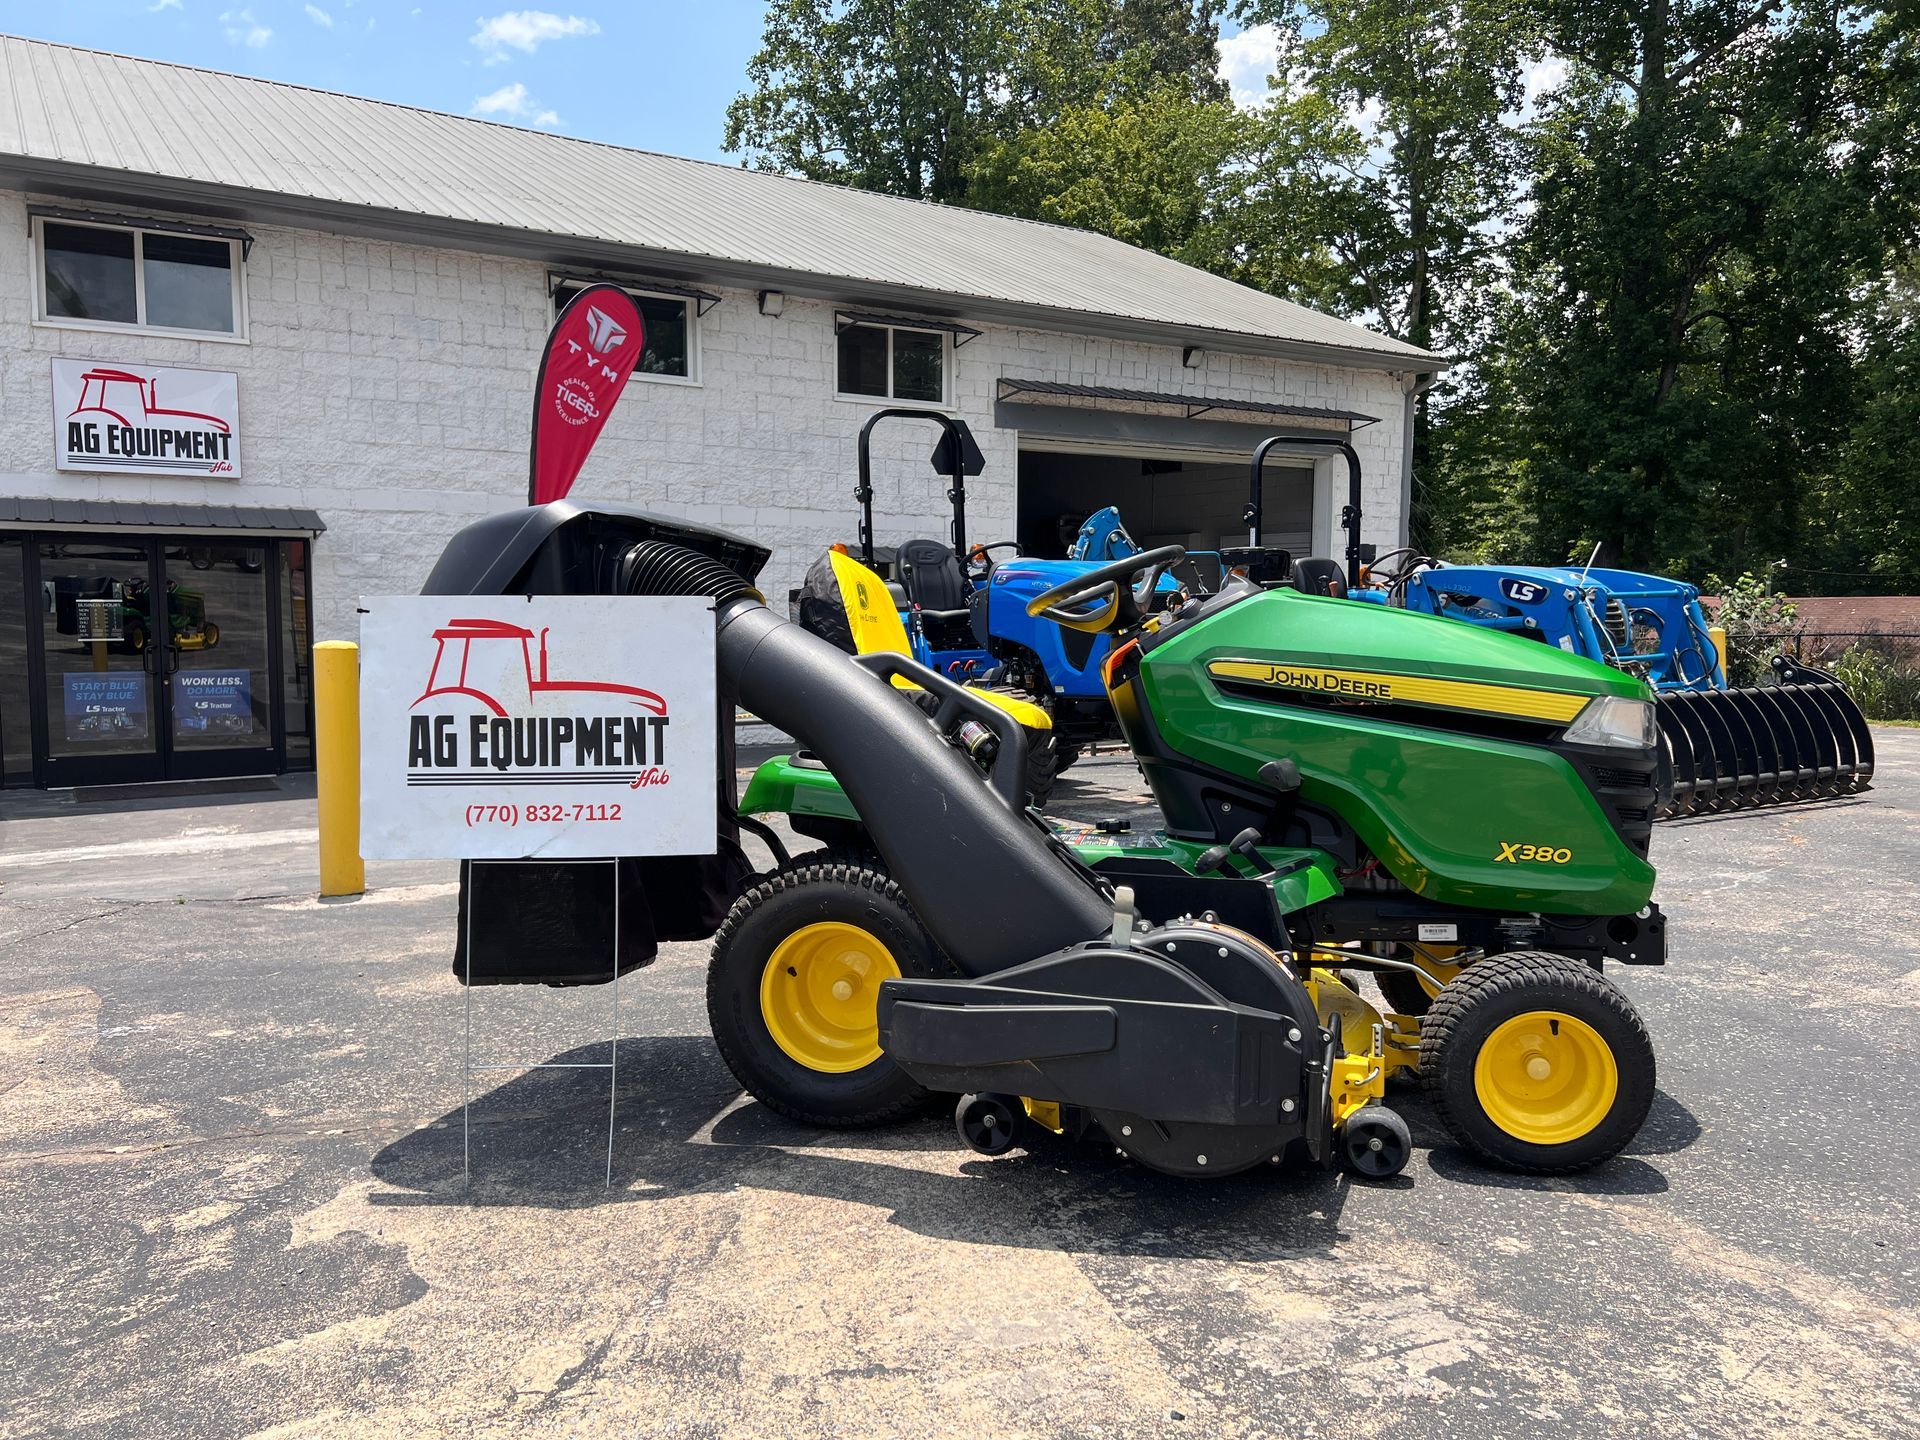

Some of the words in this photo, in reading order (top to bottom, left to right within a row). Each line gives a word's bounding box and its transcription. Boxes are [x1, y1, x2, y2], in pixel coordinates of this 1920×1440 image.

[568, 339, 618, 383] TYM
[563, 377, 590, 391] DEALER
[556, 383, 600, 418] TIGER
[554, 399, 590, 426] EXCELLENCE
[68, 422, 100, 454] AG
[108, 424, 232, 460] EQUIPMENT
[209, 460, 233, 474] Hub
[1509, 583, 1535, 601] LS
[71, 682, 108, 691] START
[109, 681, 139, 690] BLUE.
[181, 677, 215, 686] WORK
[216, 676, 243, 686] LESS.
[186, 687, 204, 695] DO
[205, 686, 238, 695] MORE.
[1264, 667, 1319, 689] JOHN
[1323, 674, 1393, 699] DEERE
[75, 692, 106, 701] STAY
[106, 691, 136, 700] BLUE.
[194, 701, 209, 709] LS
[85, 704, 101, 713] LS
[408, 715, 457, 768] AG
[470, 715, 670, 771] EQUIPMENT
[630, 767, 670, 789] Hub
[465, 805, 519, 827] (770)
[525, 804, 622, 822] 832-7112
[1492, 841, 1573, 864] X380
